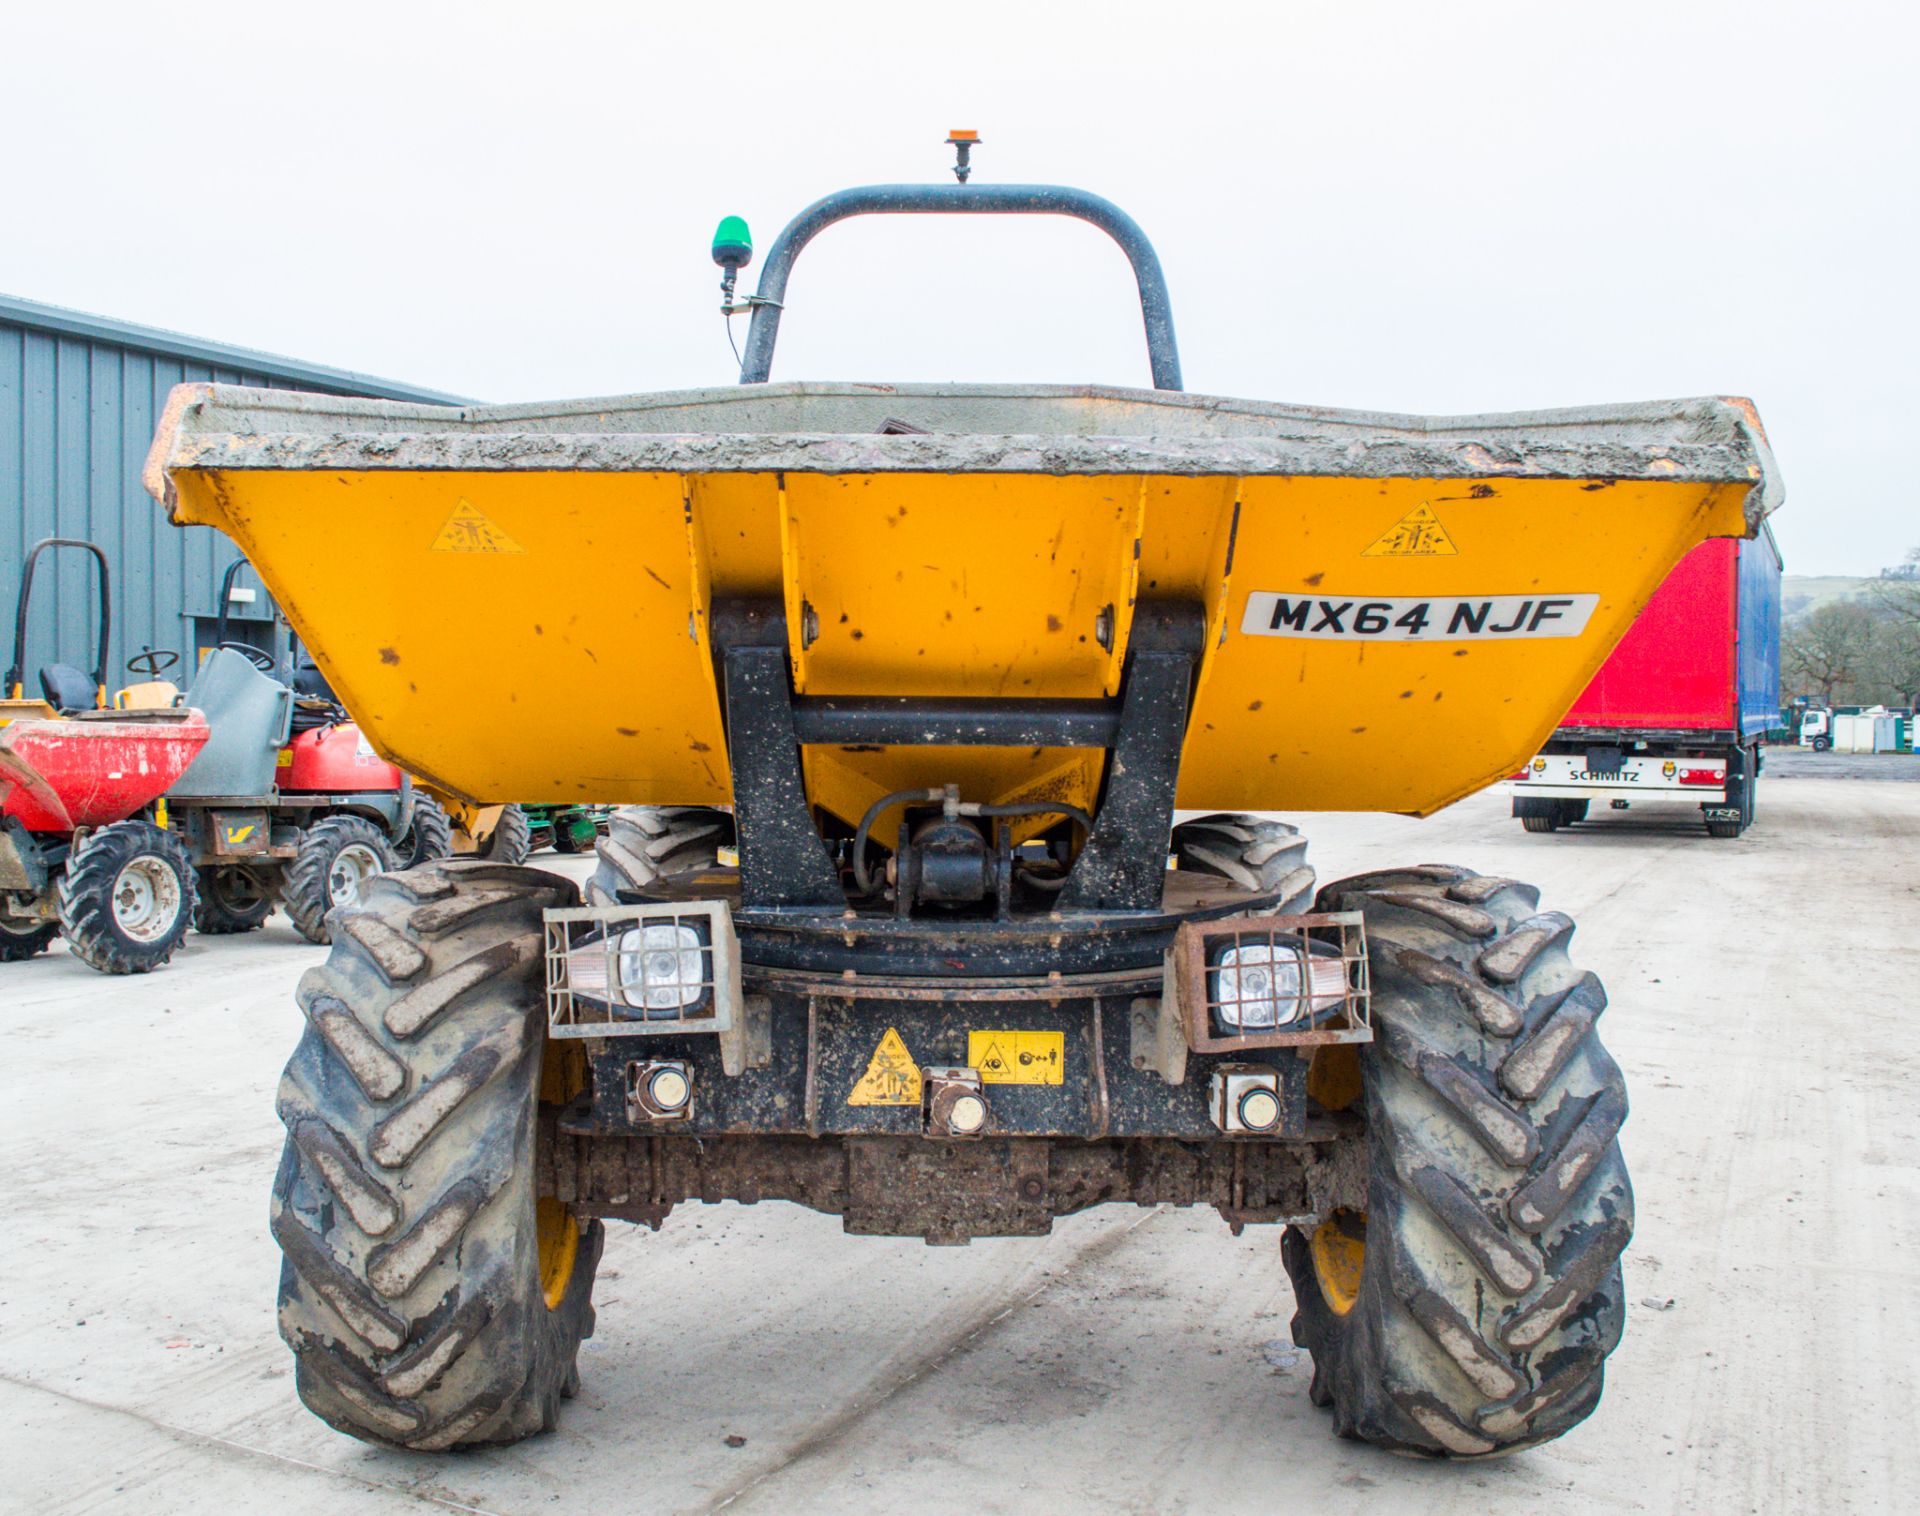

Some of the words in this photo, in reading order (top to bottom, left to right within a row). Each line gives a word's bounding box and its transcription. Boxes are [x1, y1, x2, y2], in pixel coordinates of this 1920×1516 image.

[1269, 598, 1430, 635] MX64
[1446, 599, 1574, 634] NJF
[1569, 770, 1640, 782] SCHMITZ
